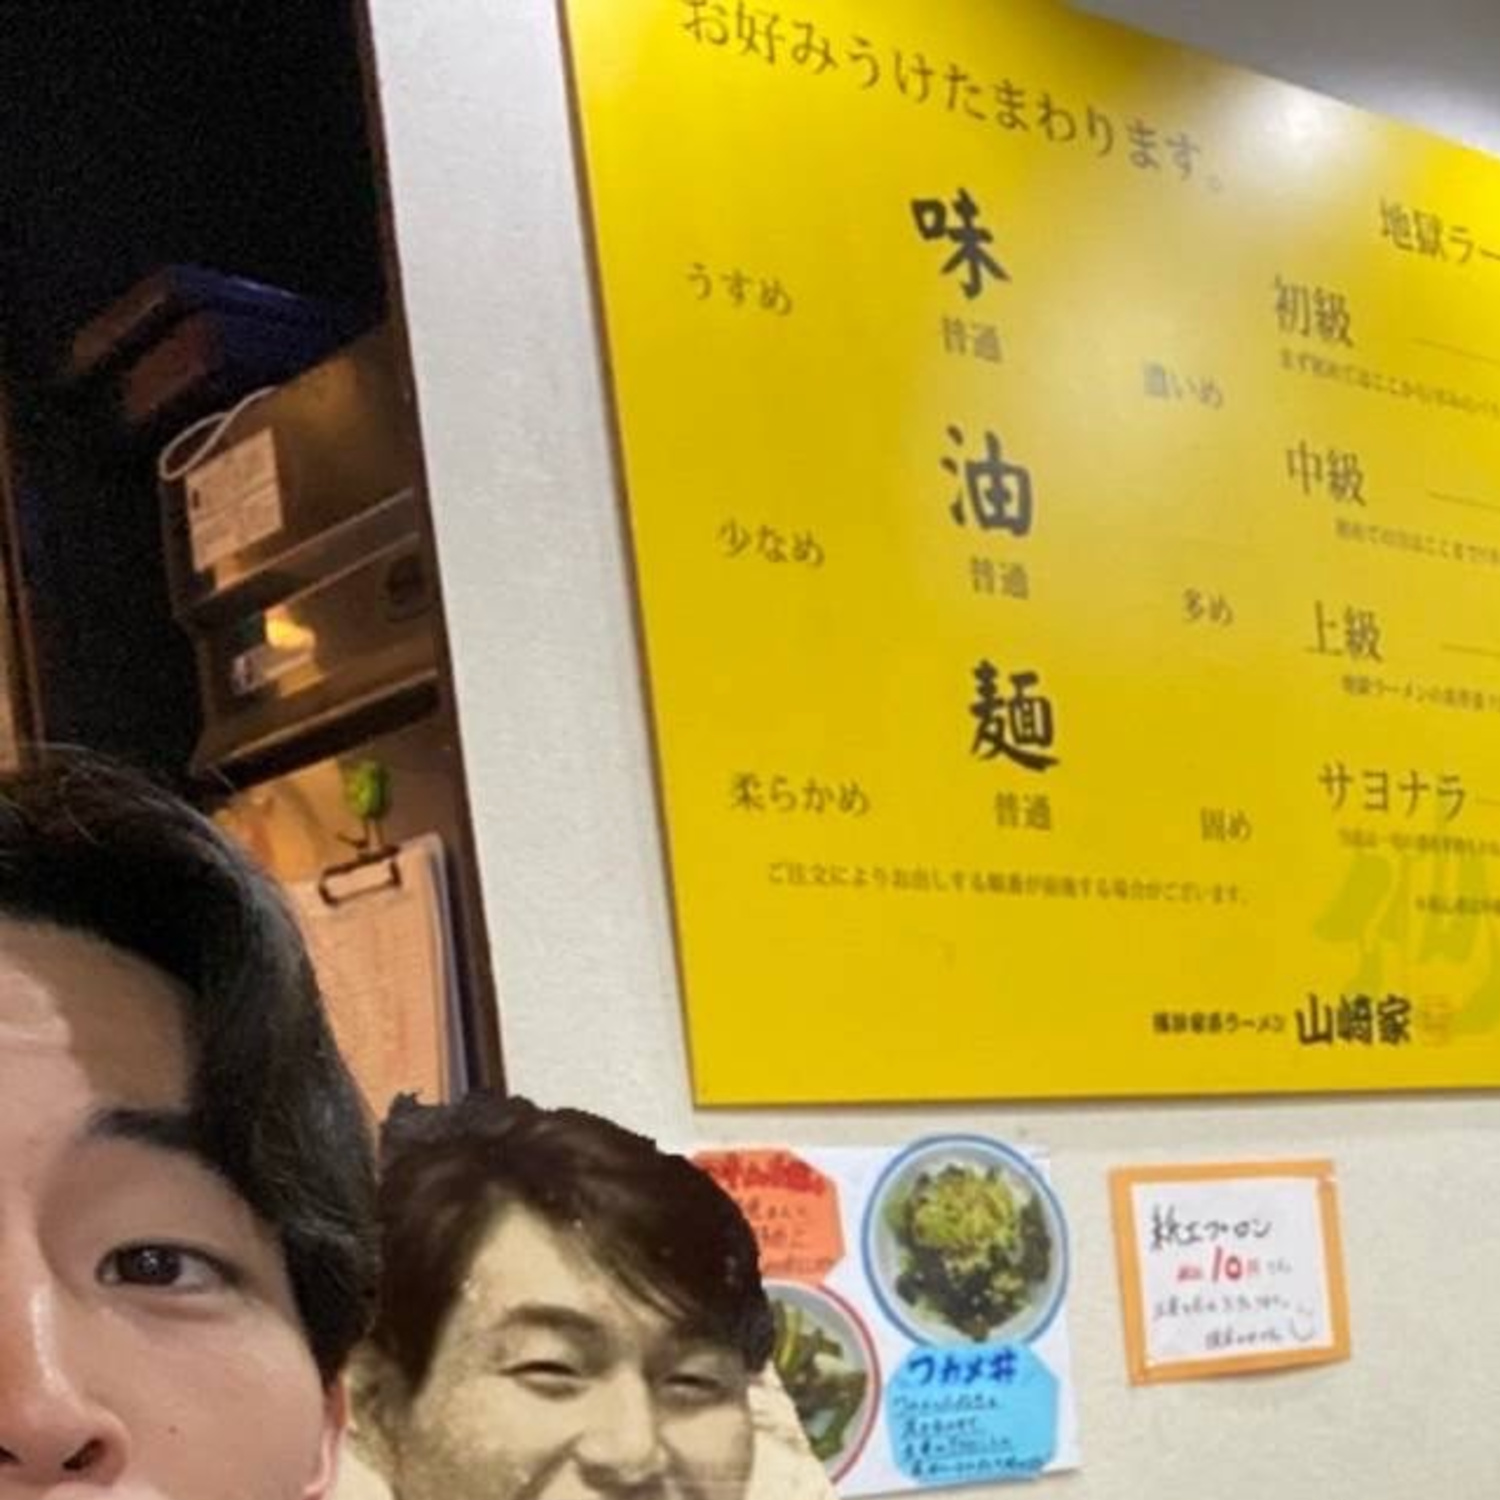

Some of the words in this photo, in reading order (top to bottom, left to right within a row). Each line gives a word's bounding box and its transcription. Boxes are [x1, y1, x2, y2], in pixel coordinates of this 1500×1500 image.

[910, 187, 1012, 300] 味
[686, 263, 793, 317] うすめ
[1274, 274, 1354, 348] 初級
[939, 316, 1004, 364] 普通
[1143, 363, 1223, 410] 濃いめ
[940, 425, 1033, 537] 油
[1286, 440, 1367, 507] 中級
[717, 518, 824, 568] 少なめ
[970, 556, 1029, 600] 普通
[1183, 589, 1234, 626] 多め
[1304, 600, 1383, 661] 上級
[970, 658, 1059, 772] 麺
[731, 773, 870, 816] 柔らかめ
[995, 792, 1052, 831] 普通
[1318, 761, 1467, 821] サヨナラ
[1199, 808, 1252, 842] 固め
